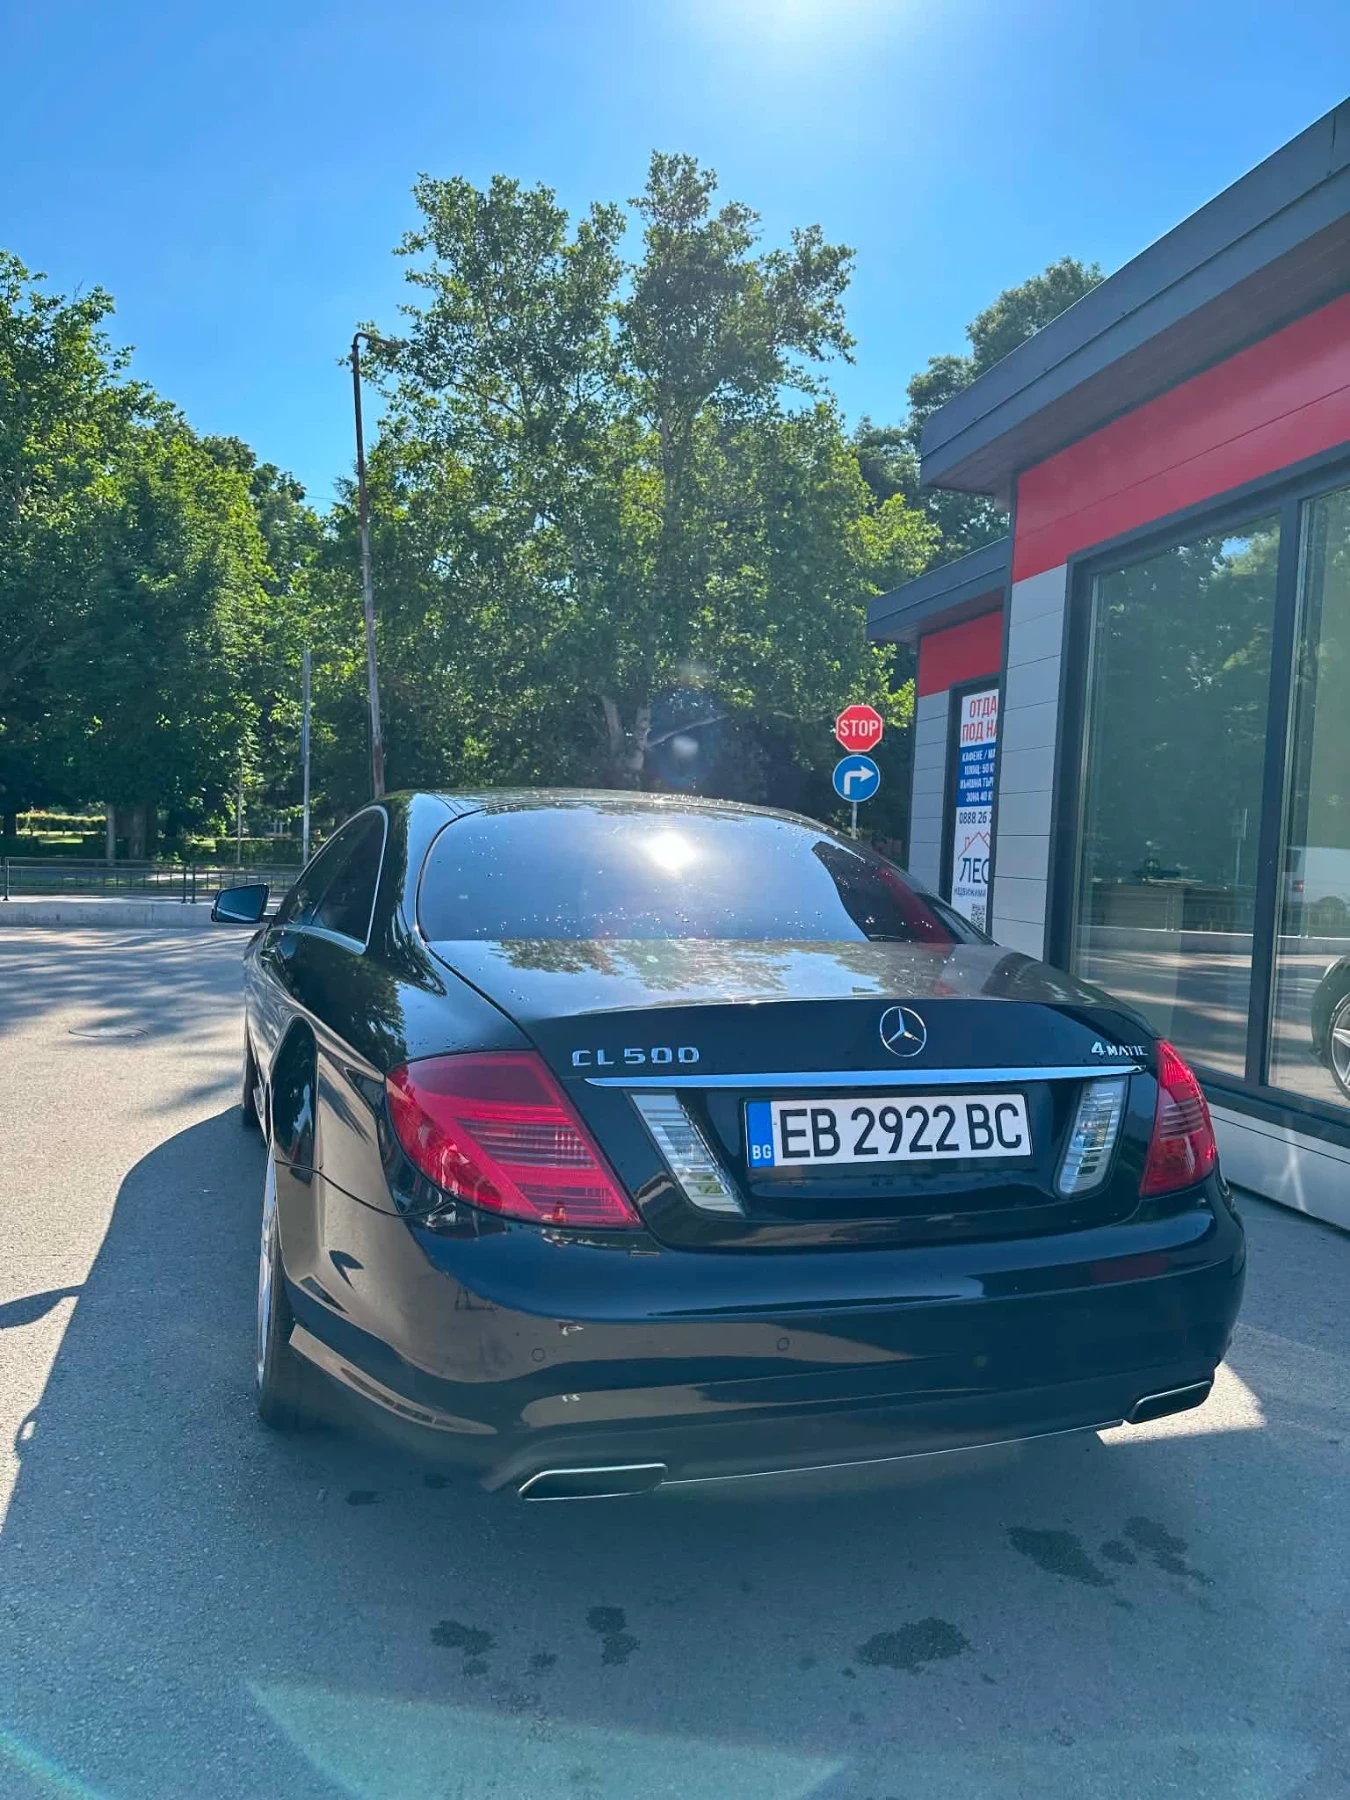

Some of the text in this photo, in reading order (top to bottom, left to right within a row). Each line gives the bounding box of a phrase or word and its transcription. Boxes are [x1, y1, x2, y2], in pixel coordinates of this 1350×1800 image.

[839, 719, 879, 737] STOP
[962, 721, 984, 742] ПОД
[959, 811, 977, 824] 0888
[977, 811, 987, 824] 26
[780, 1108, 841, 1159] EB
[850, 1105, 960, 1155] 2922
[752, 1144, 772, 1160] BG
